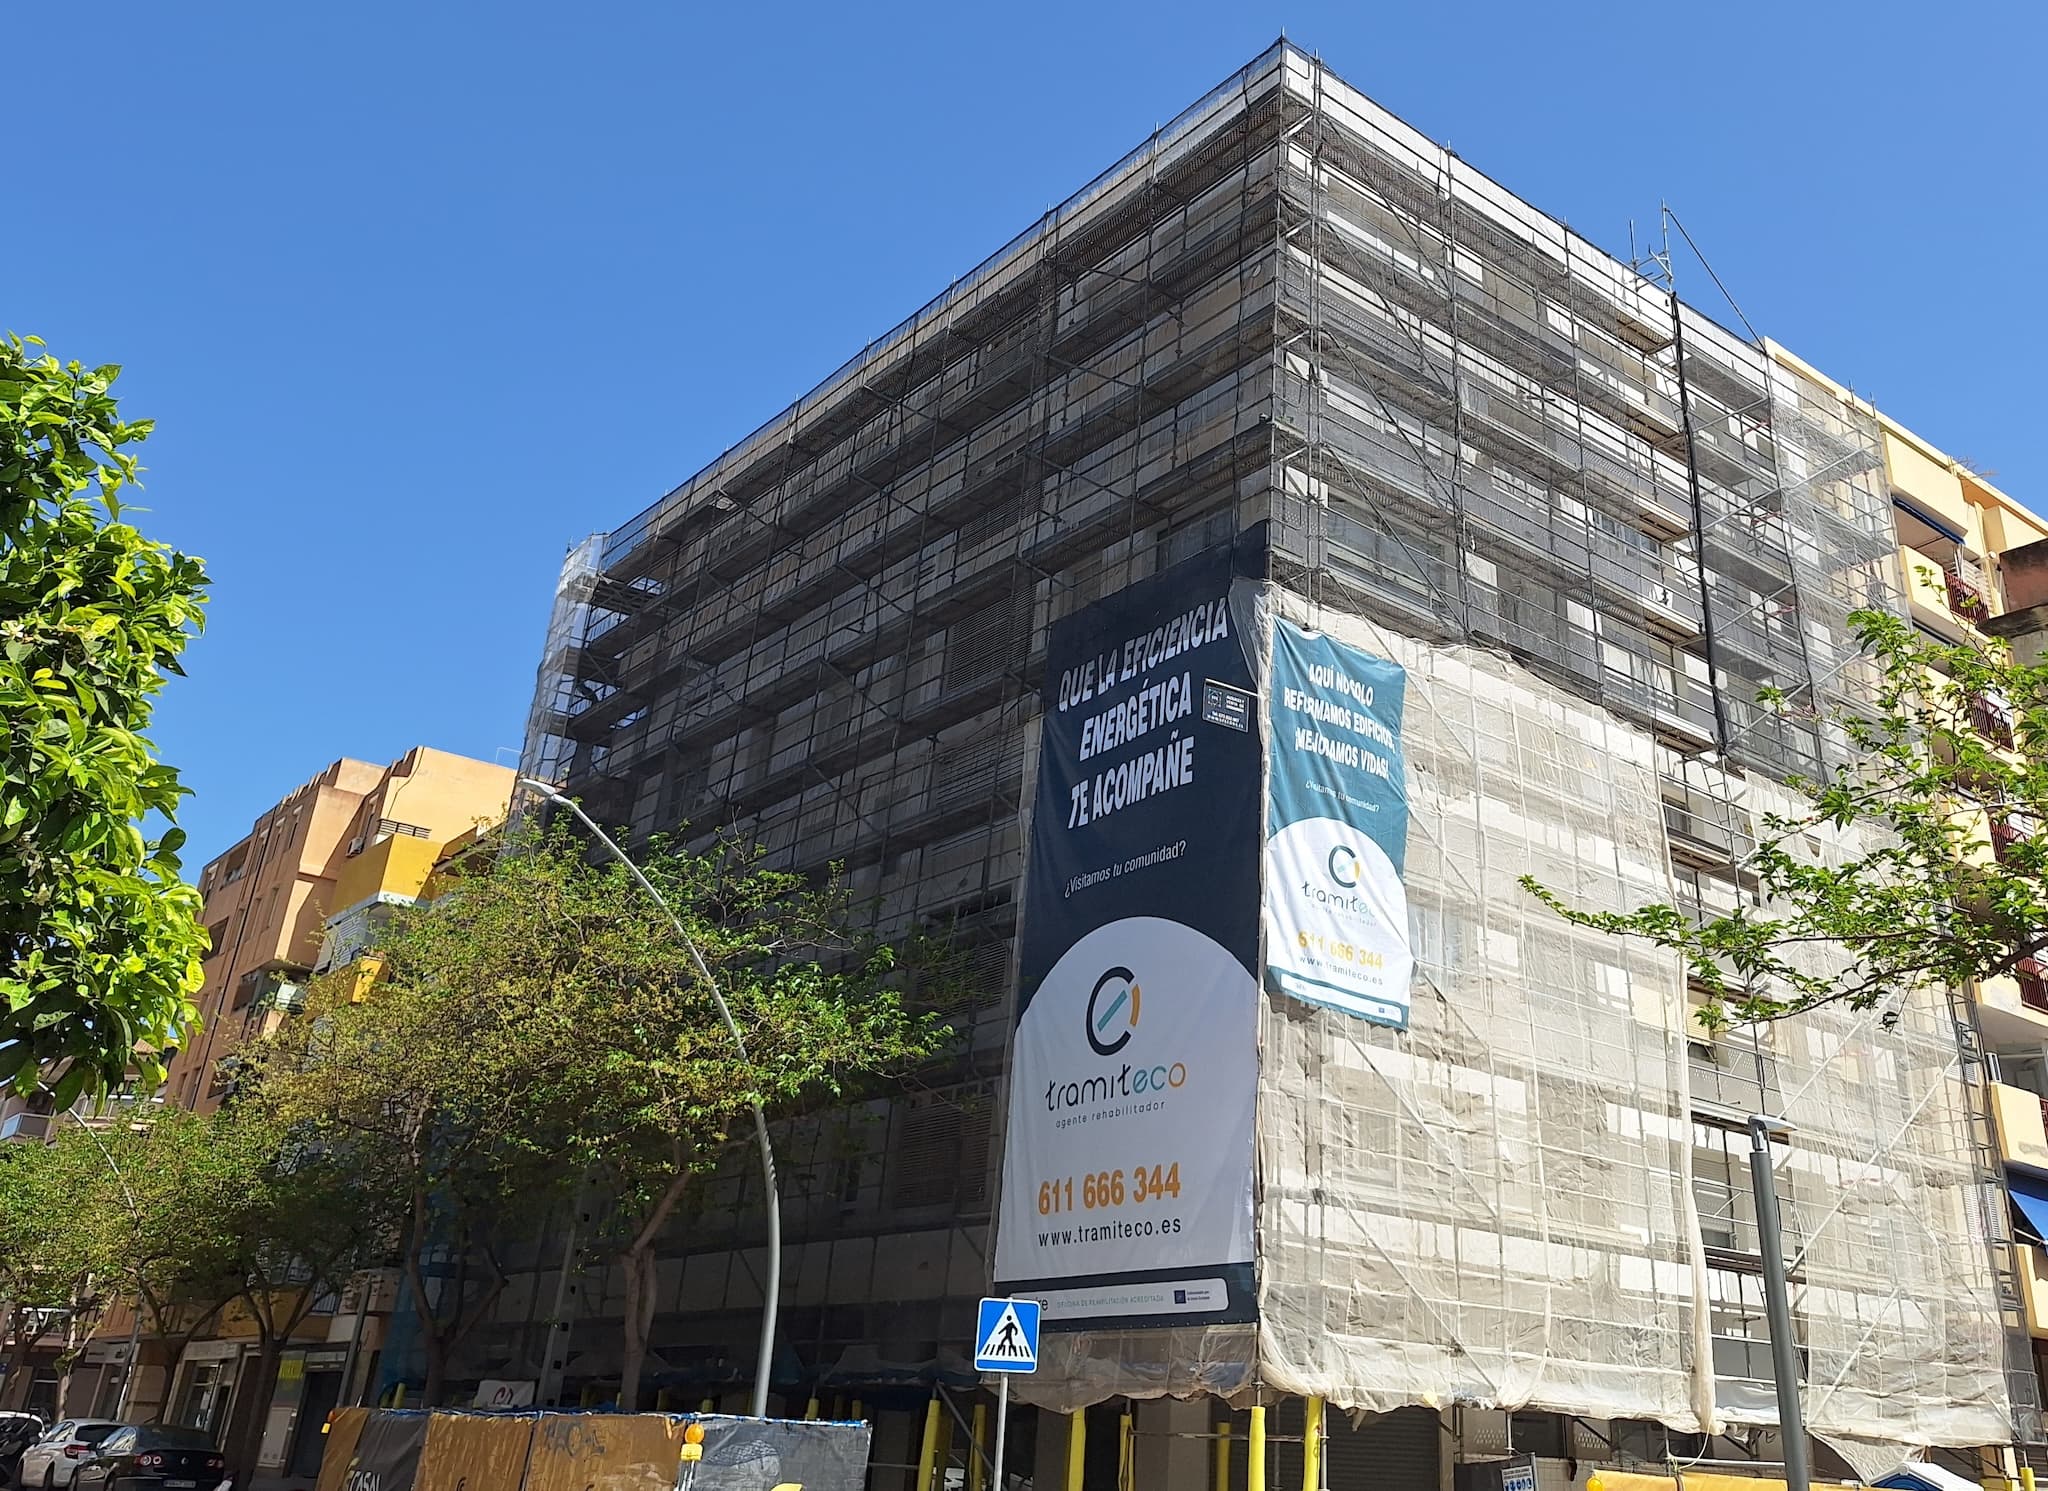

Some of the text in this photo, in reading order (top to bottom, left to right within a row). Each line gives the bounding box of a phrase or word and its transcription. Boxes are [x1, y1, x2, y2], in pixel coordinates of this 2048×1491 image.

[1058, 597, 1228, 712] QUE LA EFICIENCIA
[1308, 663, 1334, 689] AQUÍ
[1336, 671, 1350, 695] NO
[1079, 671, 1192, 762] ENERGÉTICA
[1067, 729, 1195, 829] TE ACOMPAÑE
[1064, 839, 1187, 898] ¿Visitamos tu comunidad?
[1359, 949, 1384, 970] 344
[1045, 1062, 1186, 1112] tramiteco
[1055, 1100, 1166, 1129] agente rehabilitador
[1038, 1162, 1181, 1215] 611 666 344
[1038, 1218, 1181, 1247] www.tramiteco.es
